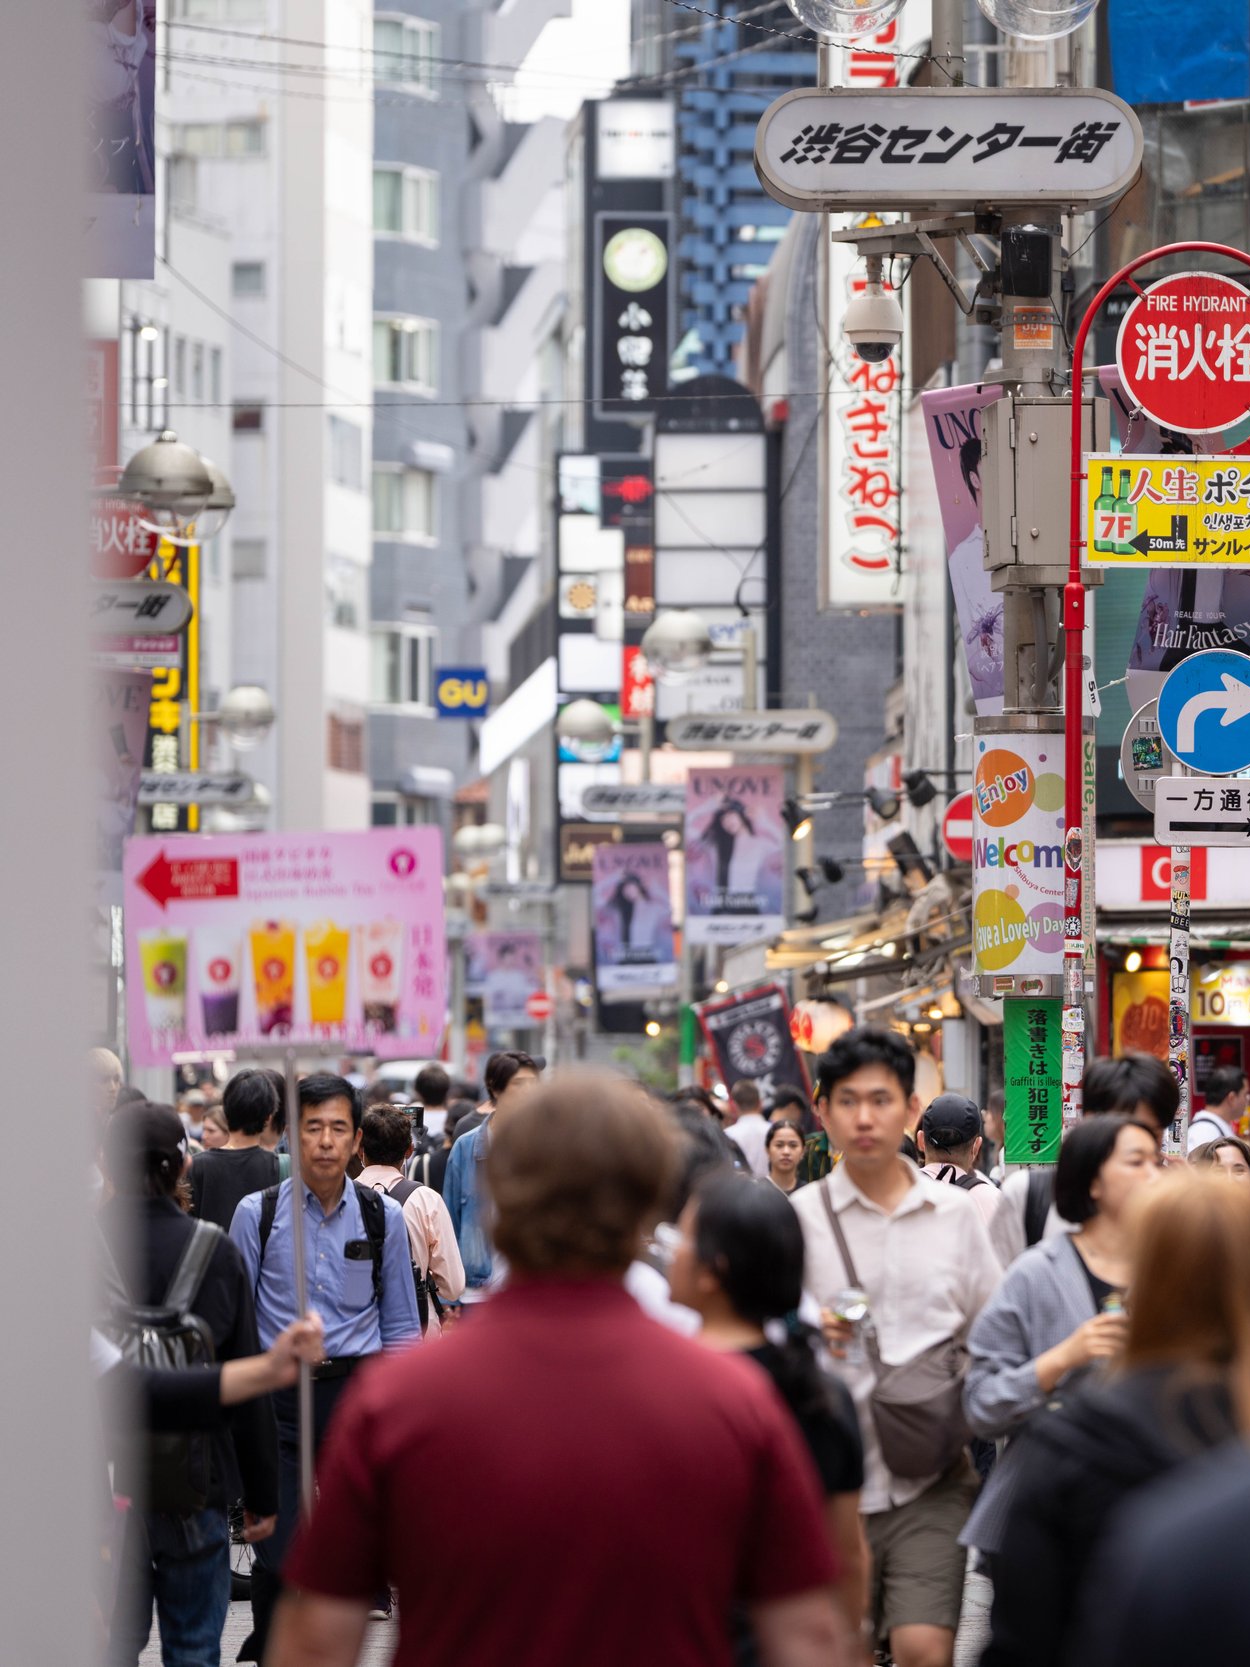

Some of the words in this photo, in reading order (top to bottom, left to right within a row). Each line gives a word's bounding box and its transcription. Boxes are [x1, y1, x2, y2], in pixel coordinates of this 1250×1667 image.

[780, 121, 1121, 164] 渋谷センター街
[1147, 295, 1177, 311] FIRE
[1183, 296, 1248, 312] HYDRANT
[1129, 469, 1198, 502] 人生
[1100, 516, 1132, 539] 7F
[1149, 538, 1186, 550] 50m先
[1174, 610, 1203, 619] REALIZE
[1206, 611, 1227, 620] YOUR
[1152, 622, 1186, 648] Hair
[976, 768, 1028, 815] Enjoy
[1013, 865, 1039, 891] Shibuya
[1040, 886, 1065, 897] Center
[993, 927, 1001, 946] a
[1000, 915, 1040, 945] Lovely
[1043, 916, 1065, 936] Day
[1010, 1076, 1035, 1086] Graffiti
[1037, 1076, 1044, 1086] is
[1027, 1009, 1049, 1154] 落書きは犯罪です
